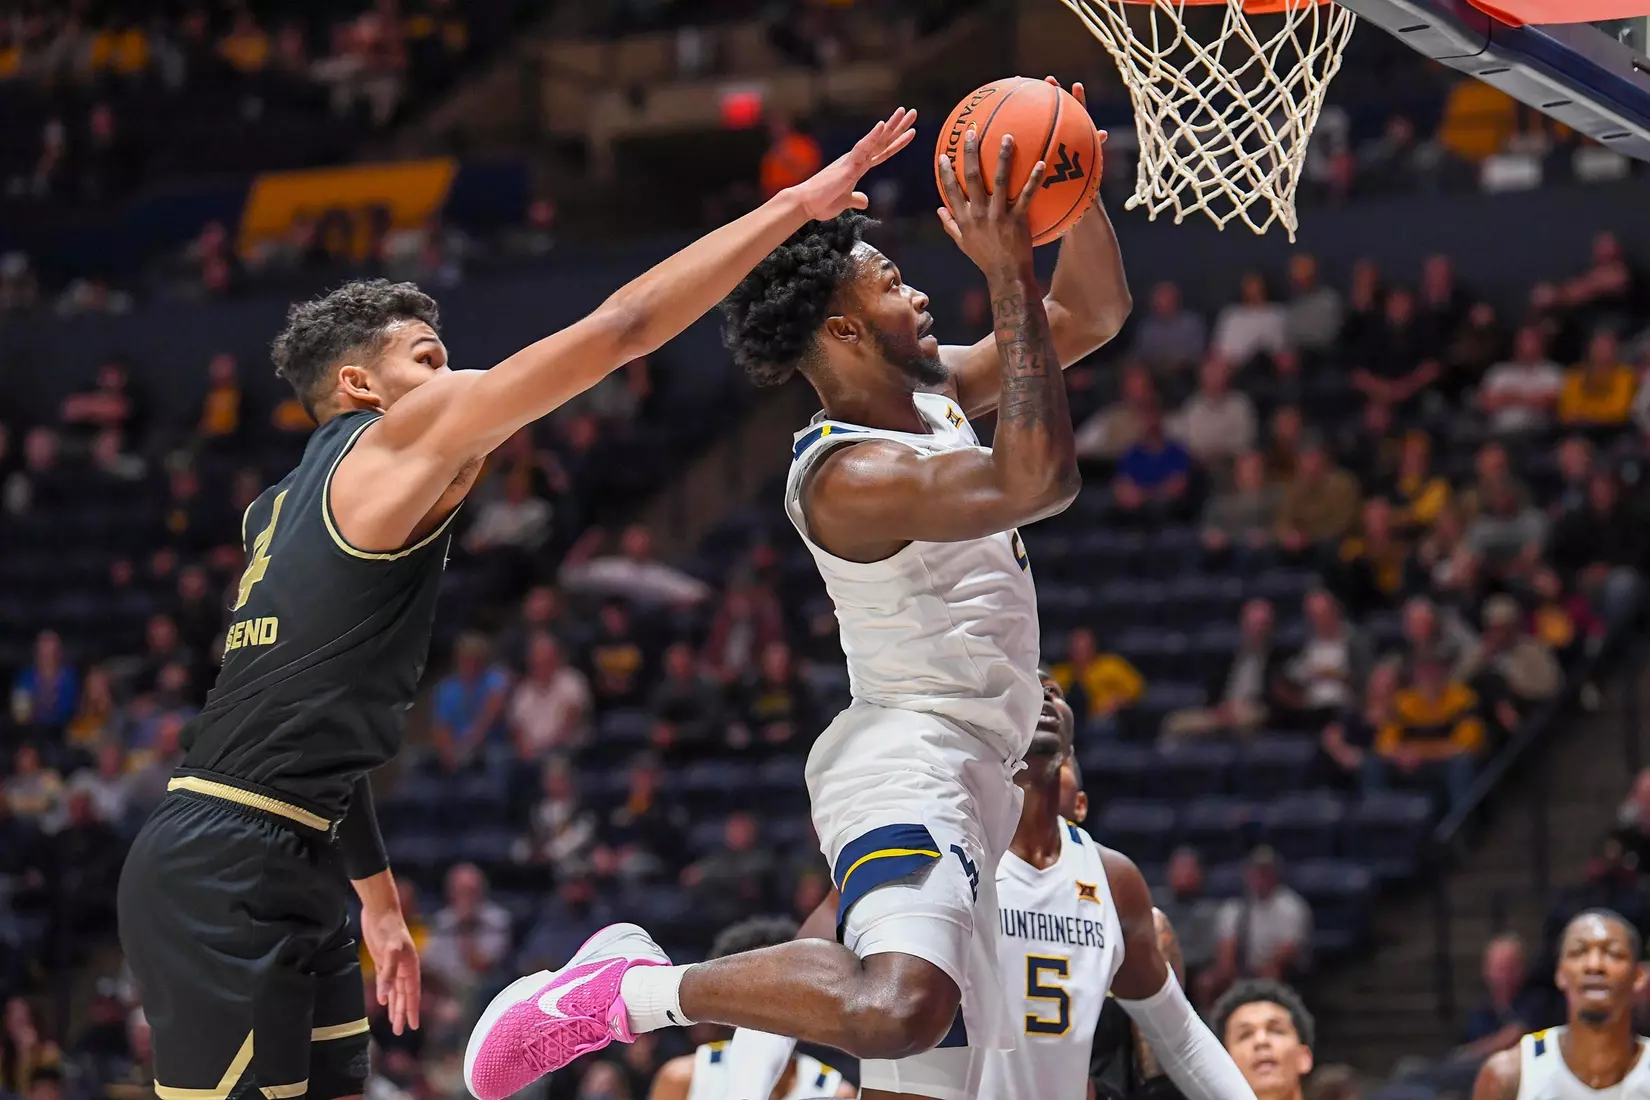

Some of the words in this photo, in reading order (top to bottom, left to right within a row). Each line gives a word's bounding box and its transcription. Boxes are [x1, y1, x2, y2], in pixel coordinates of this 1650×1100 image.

[946, 87, 998, 172] SPALDIN
[999, 908, 1104, 949] UNTAINEERS
[1025, 954, 1071, 1036] 5
